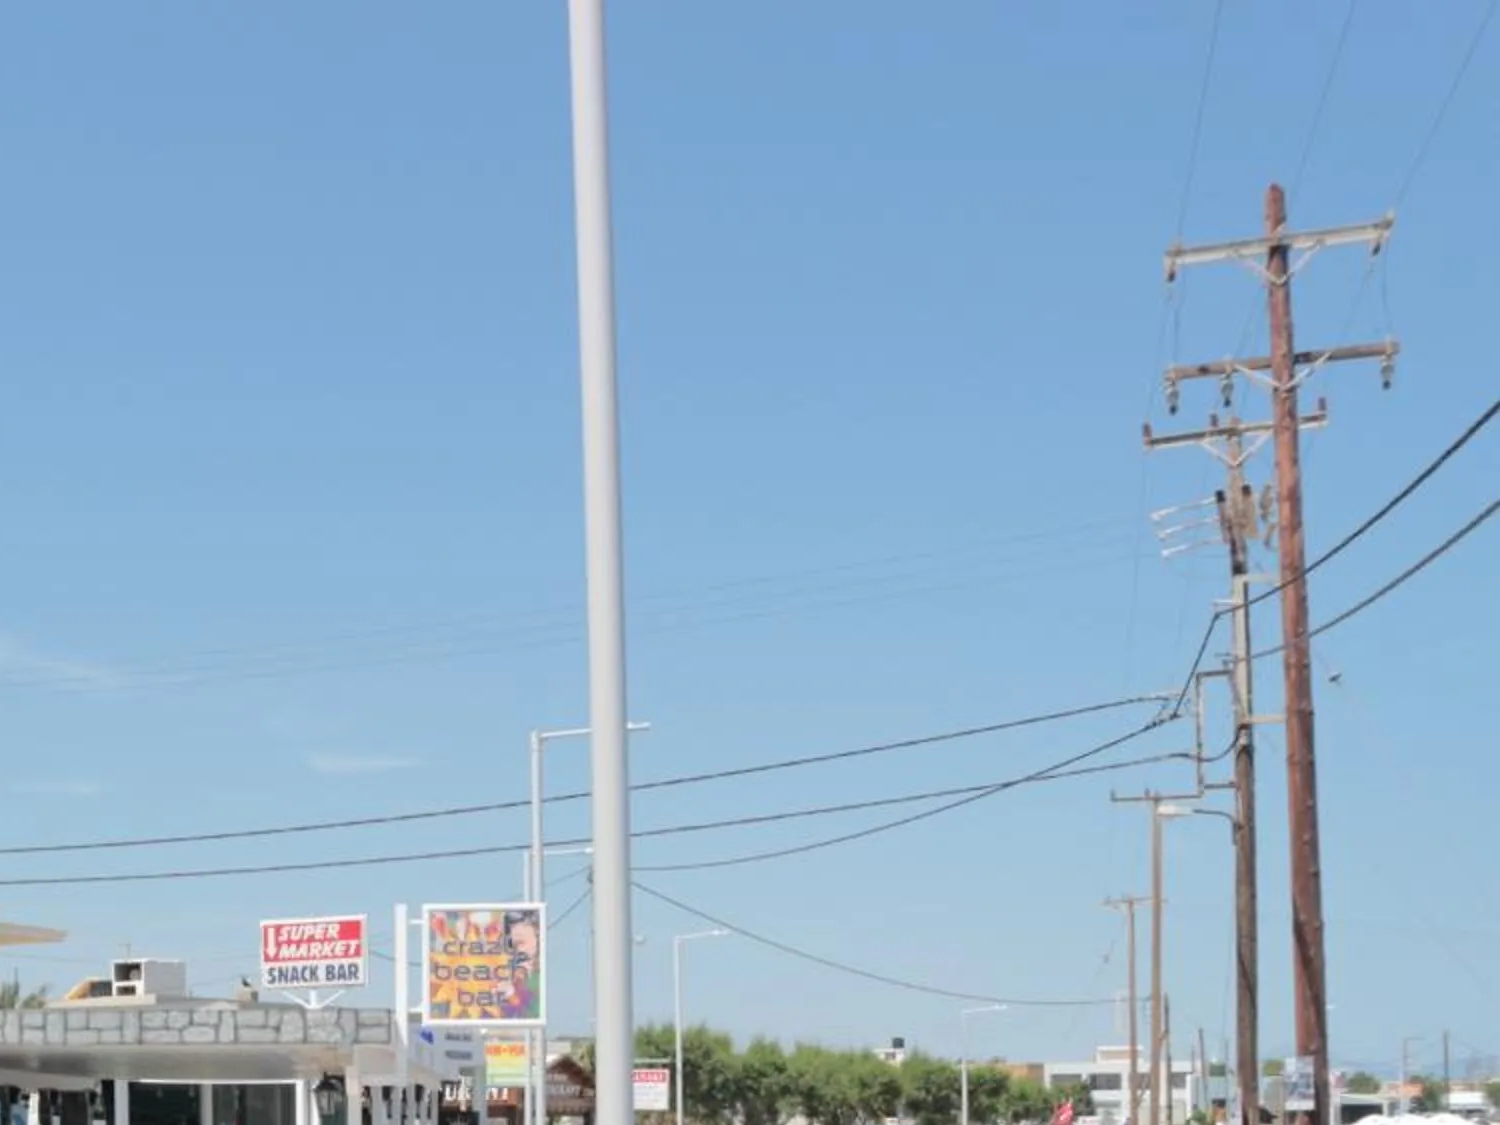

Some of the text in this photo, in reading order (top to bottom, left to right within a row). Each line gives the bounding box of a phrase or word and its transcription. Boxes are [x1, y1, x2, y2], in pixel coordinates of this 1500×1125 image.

[278, 923, 340, 942] SUPER
[279, 940, 360, 959] MARKET
[267, 963, 360, 984] SNACK BAR
[435, 956, 528, 981] beach
[457, 986, 509, 1007] bar
